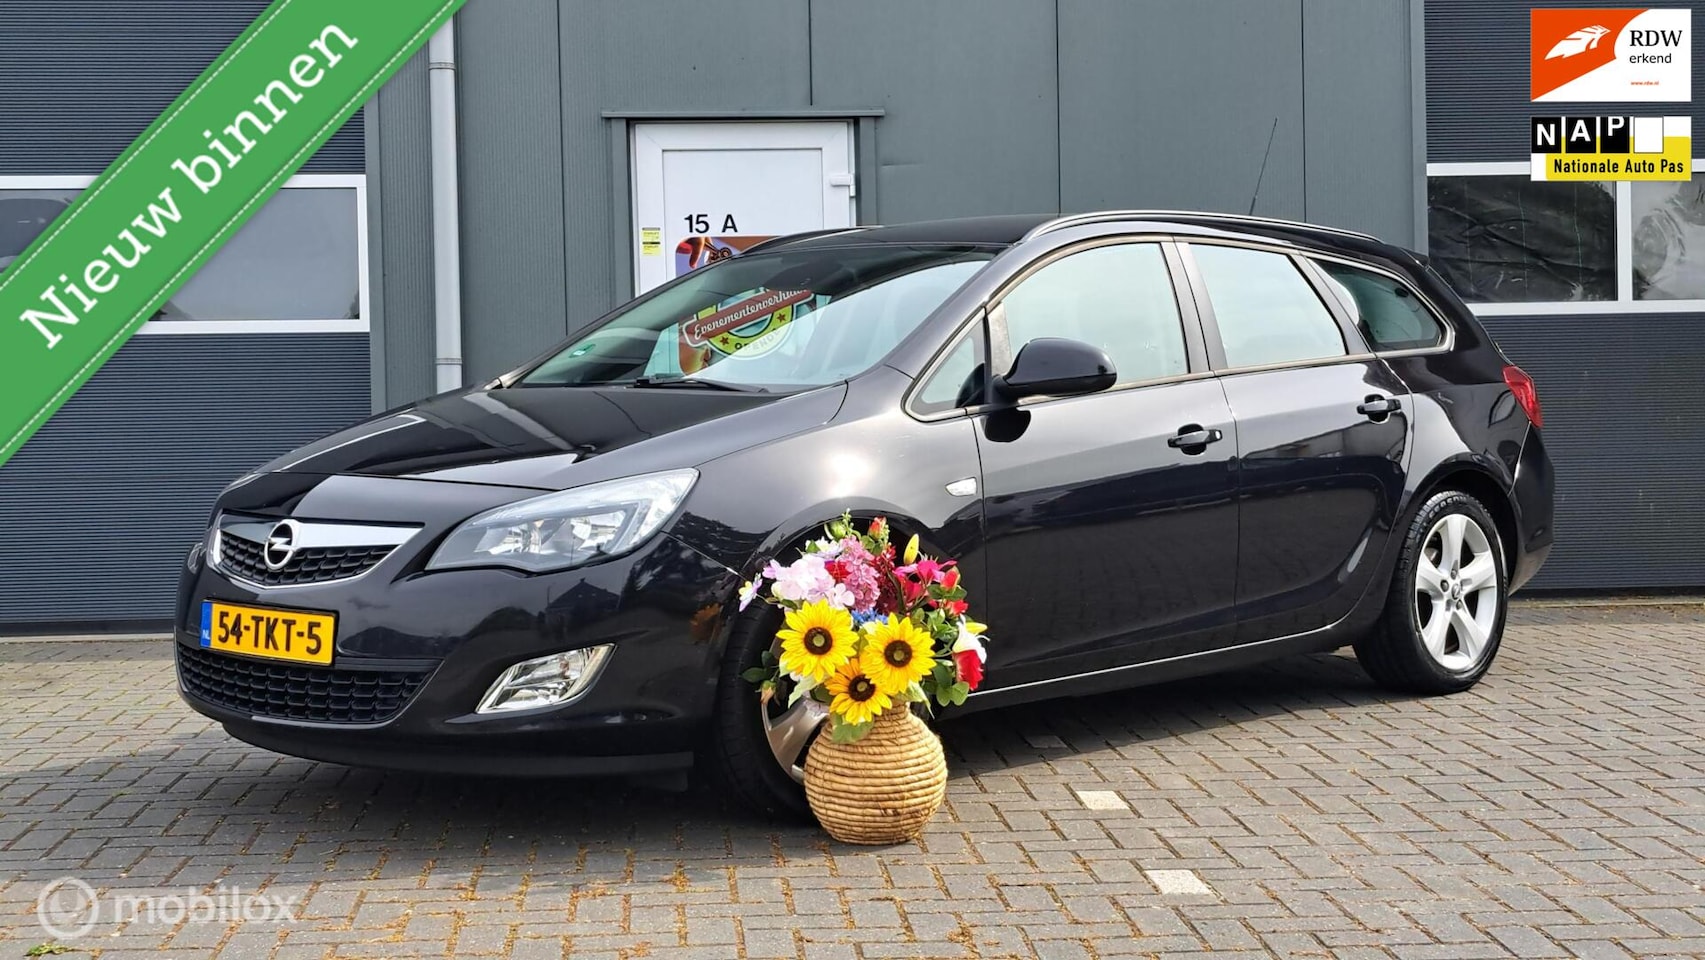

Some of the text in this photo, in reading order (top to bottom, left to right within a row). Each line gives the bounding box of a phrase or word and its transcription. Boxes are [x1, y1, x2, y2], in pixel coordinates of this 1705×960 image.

[684, 214, 738, 233] 15 A
[202, 629, 211, 640] NL
[218, 611, 322, 655] 54-TKT-5
